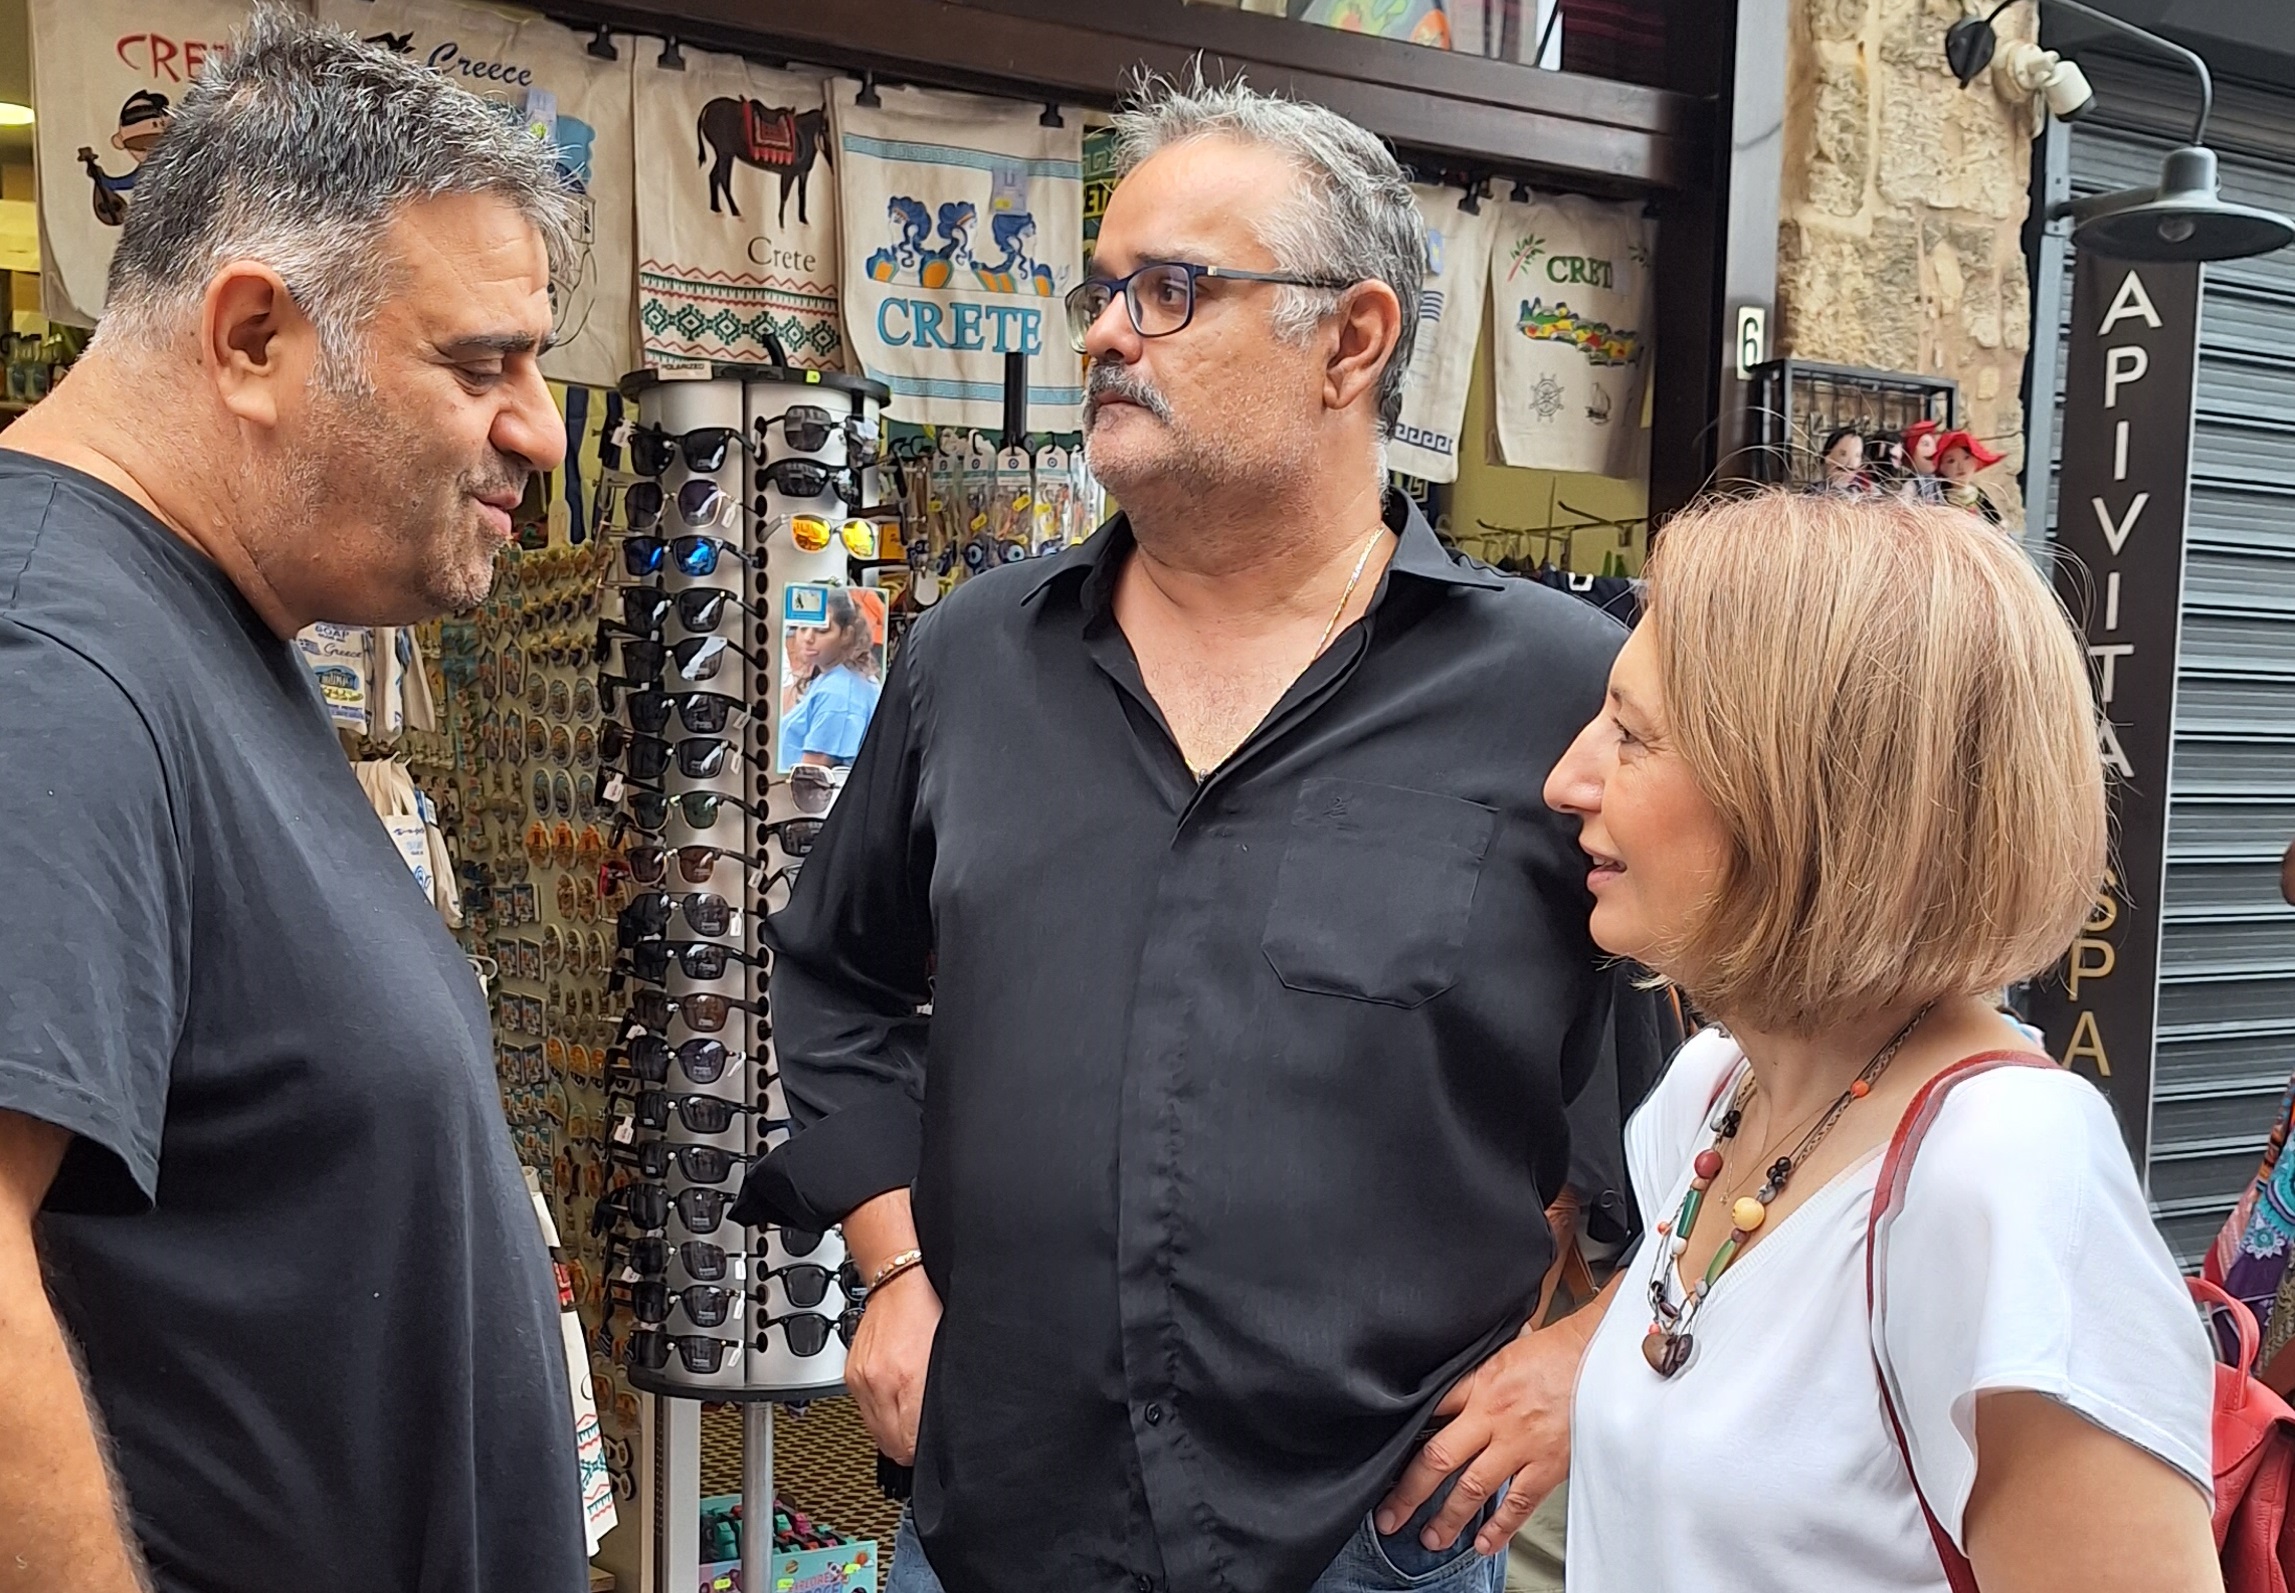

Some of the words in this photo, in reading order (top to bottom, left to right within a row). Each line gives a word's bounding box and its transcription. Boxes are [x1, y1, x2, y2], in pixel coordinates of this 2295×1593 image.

[117, 33, 227, 82] CRE
[747, 236, 816, 273] Crete
[1547, 256, 1613, 289] CRET
[878, 297, 1042, 355] CRETE
[1743, 317, 1759, 374] 6
[2090, 270, 2164, 778] APIVITA
[323, 643, 363, 657] Greece
